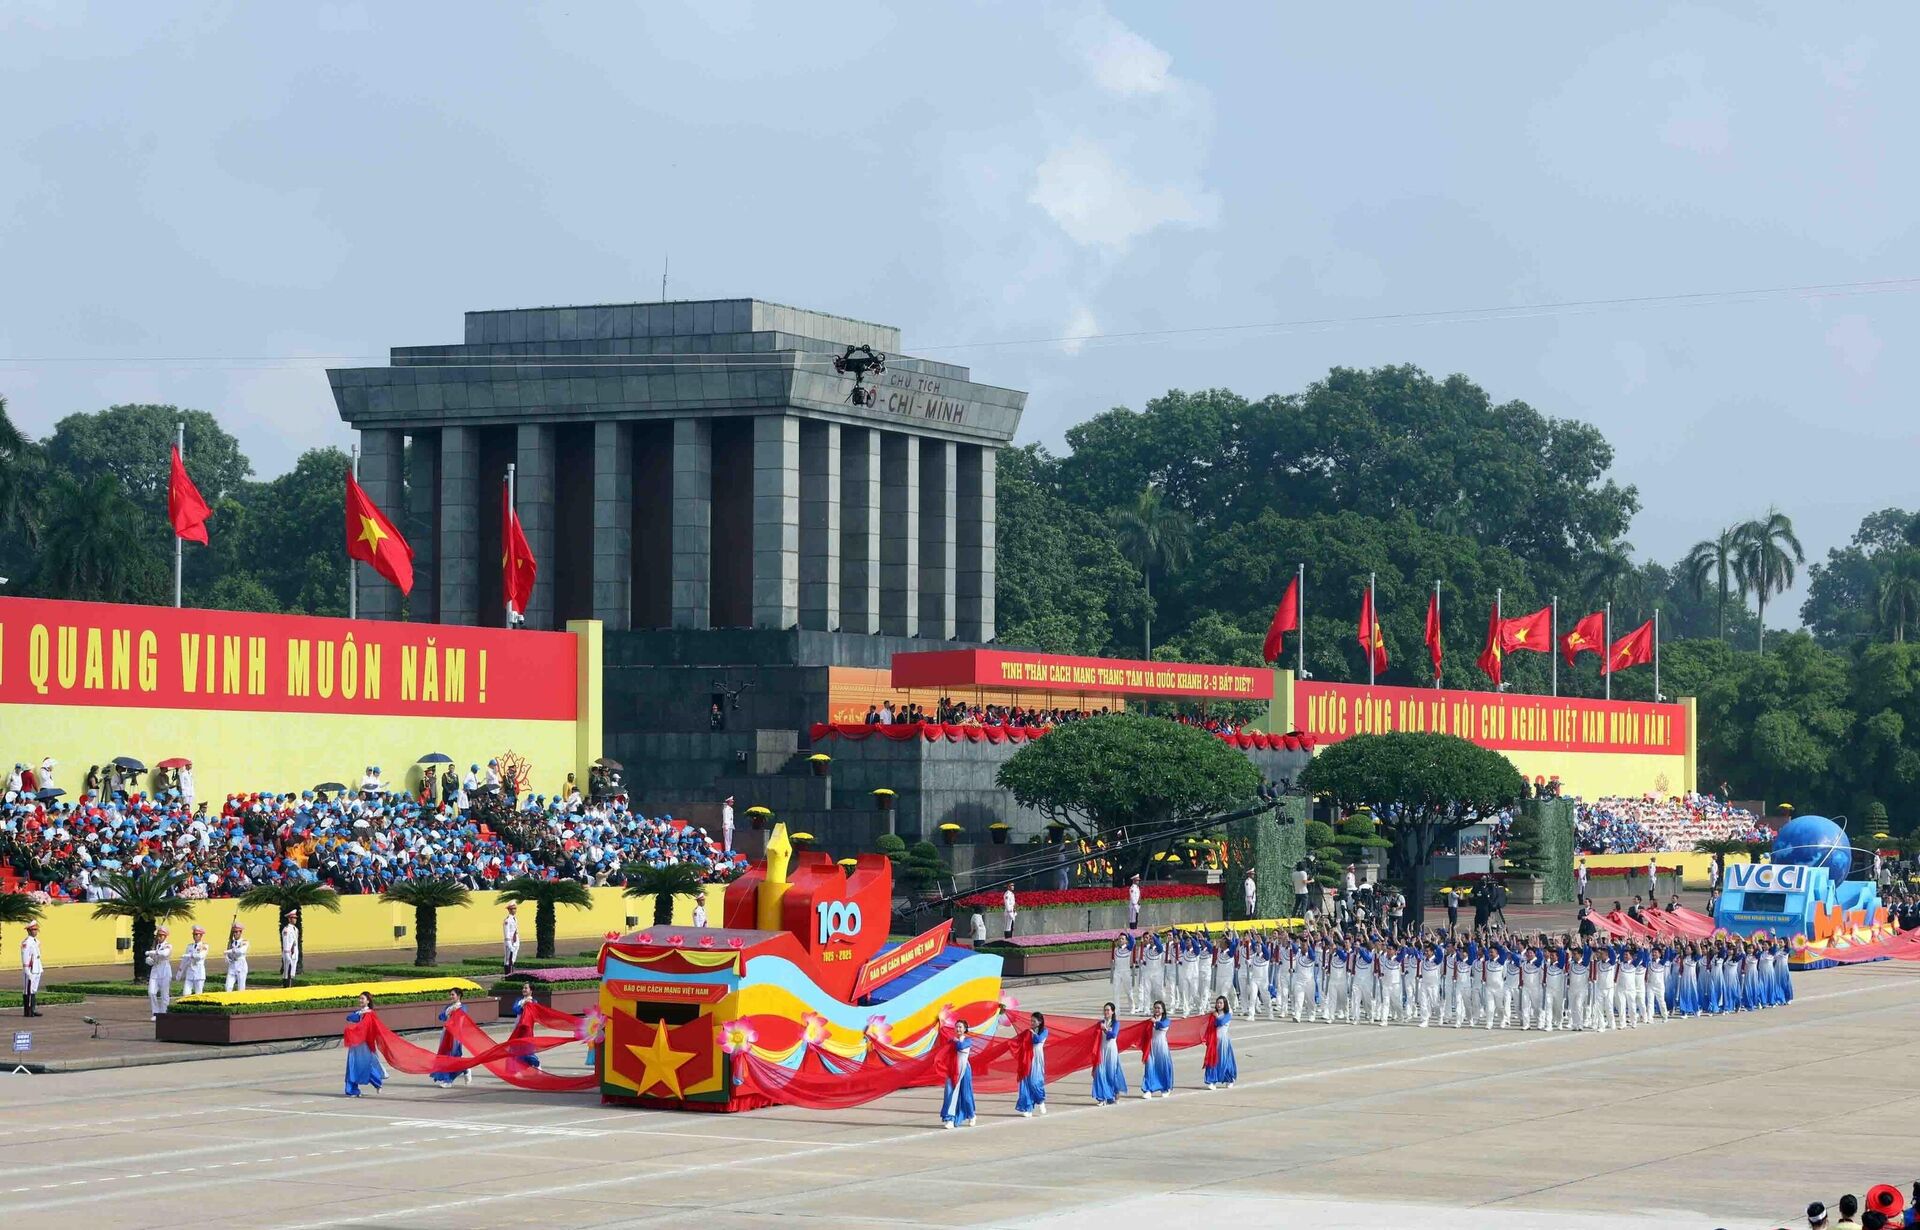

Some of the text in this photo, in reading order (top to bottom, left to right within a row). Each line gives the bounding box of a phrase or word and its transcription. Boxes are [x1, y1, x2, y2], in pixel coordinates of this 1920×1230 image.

[30, 623, 158, 694] QUANG
[181, 632, 266, 695] VINH
[288, 631, 381, 699] MUÔN
[1001, 661, 1022, 680] TINH
[1050, 661, 1071, 682] CÁCH
[1073, 667, 1096, 687] MẠNG
[1097, 666, 1123, 686] THÁNG
[1126, 667, 1143, 687] TÁM
[1145, 668, 1155, 688] VÀ
[1156, 667, 1175, 689] QUỐC
[1177, 670, 1202, 690] KHÁNH
[1203, 674, 1217, 691] 2-9
[1219, 671, 1233, 691] BẤT
[1308, 690, 1346, 735] NƯỚC
[1400, 695, 1424, 733] HÒA
[1432, 696, 1447, 734] XÃ
[1481, 696, 1505, 740] CHỦ
[1511, 703, 1548, 742] NGHĨA
[1553, 704, 1578, 749] VIỆT
[1582, 710, 1605, 744] NAM
[1610, 707, 1639, 745] MUÔN
[1734, 864, 1805, 889] VCCI
[816, 900, 862, 944] 100
[914, 942, 924, 958] VIỆT
[924, 937, 935, 952] NAM
[623, 983, 709, 997] BÁO CHÍ CÁCH MẠNG VIỆT NAM
